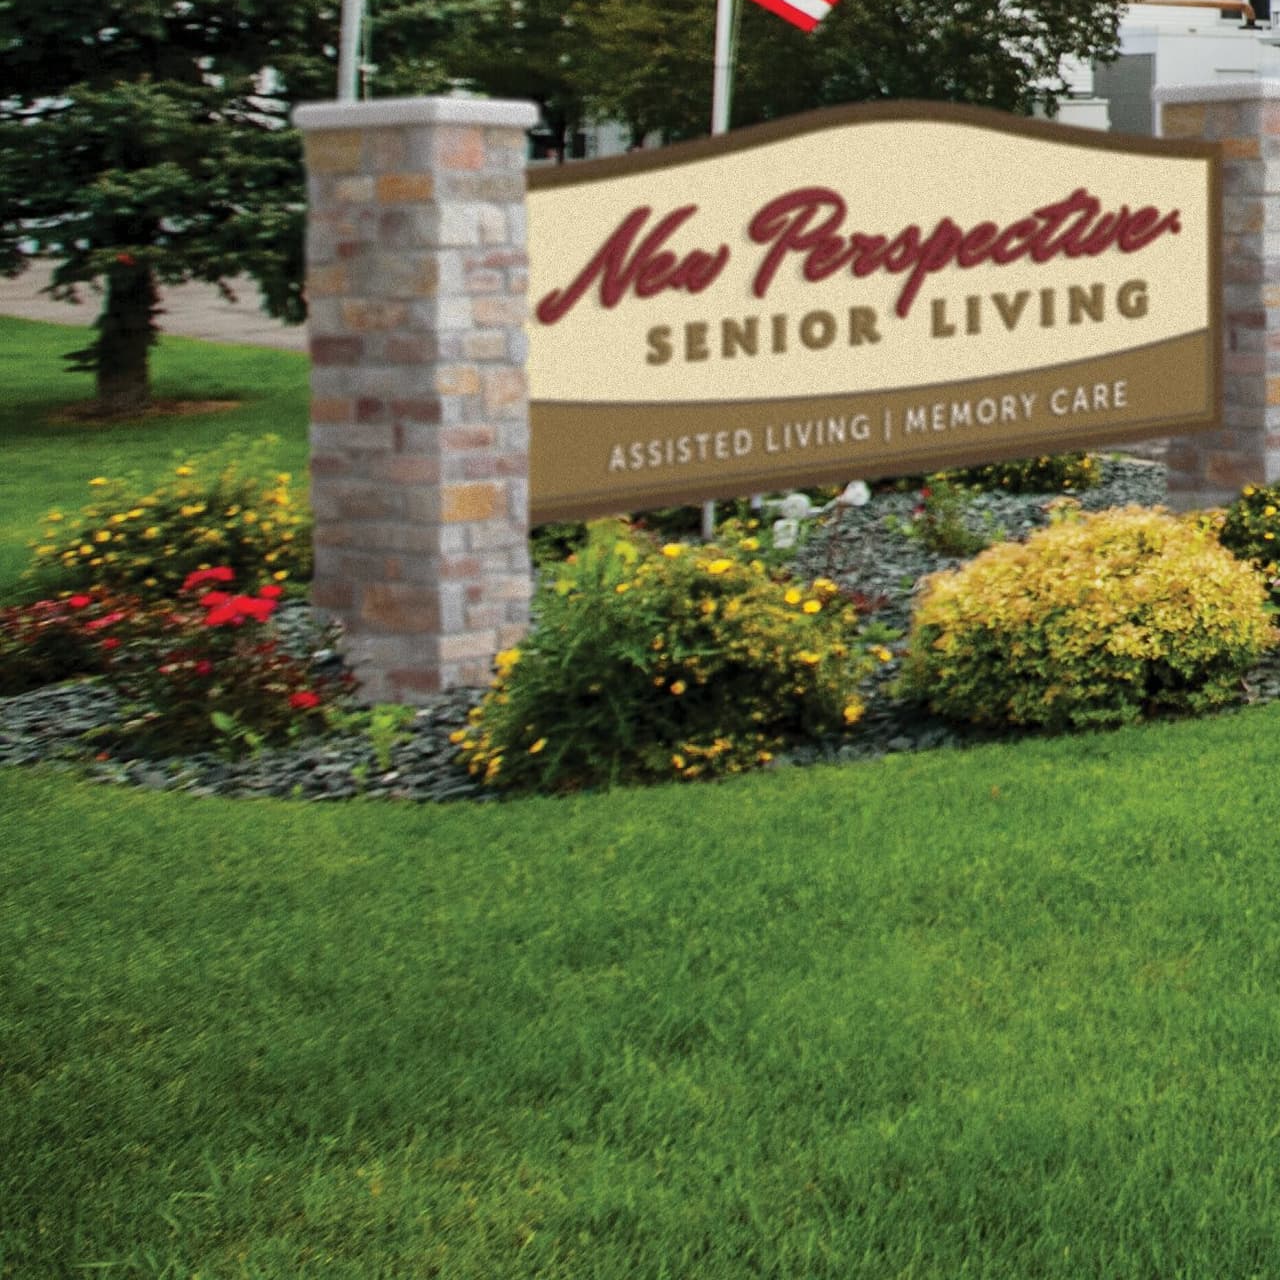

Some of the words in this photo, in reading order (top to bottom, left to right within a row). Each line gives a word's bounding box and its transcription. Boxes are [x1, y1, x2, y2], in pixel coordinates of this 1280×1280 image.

[536, 204, 730, 325] New
[746, 185, 1182, 318] Perspective
[645, 305, 882, 366] SENIOR
[930, 279, 1152, 339] LIVING
[610, 430, 753, 471] ASSISTED
[767, 415, 870, 451] LIVING
[905, 395, 1036, 433] MEMORY
[1051, 380, 1129, 417] CARE
